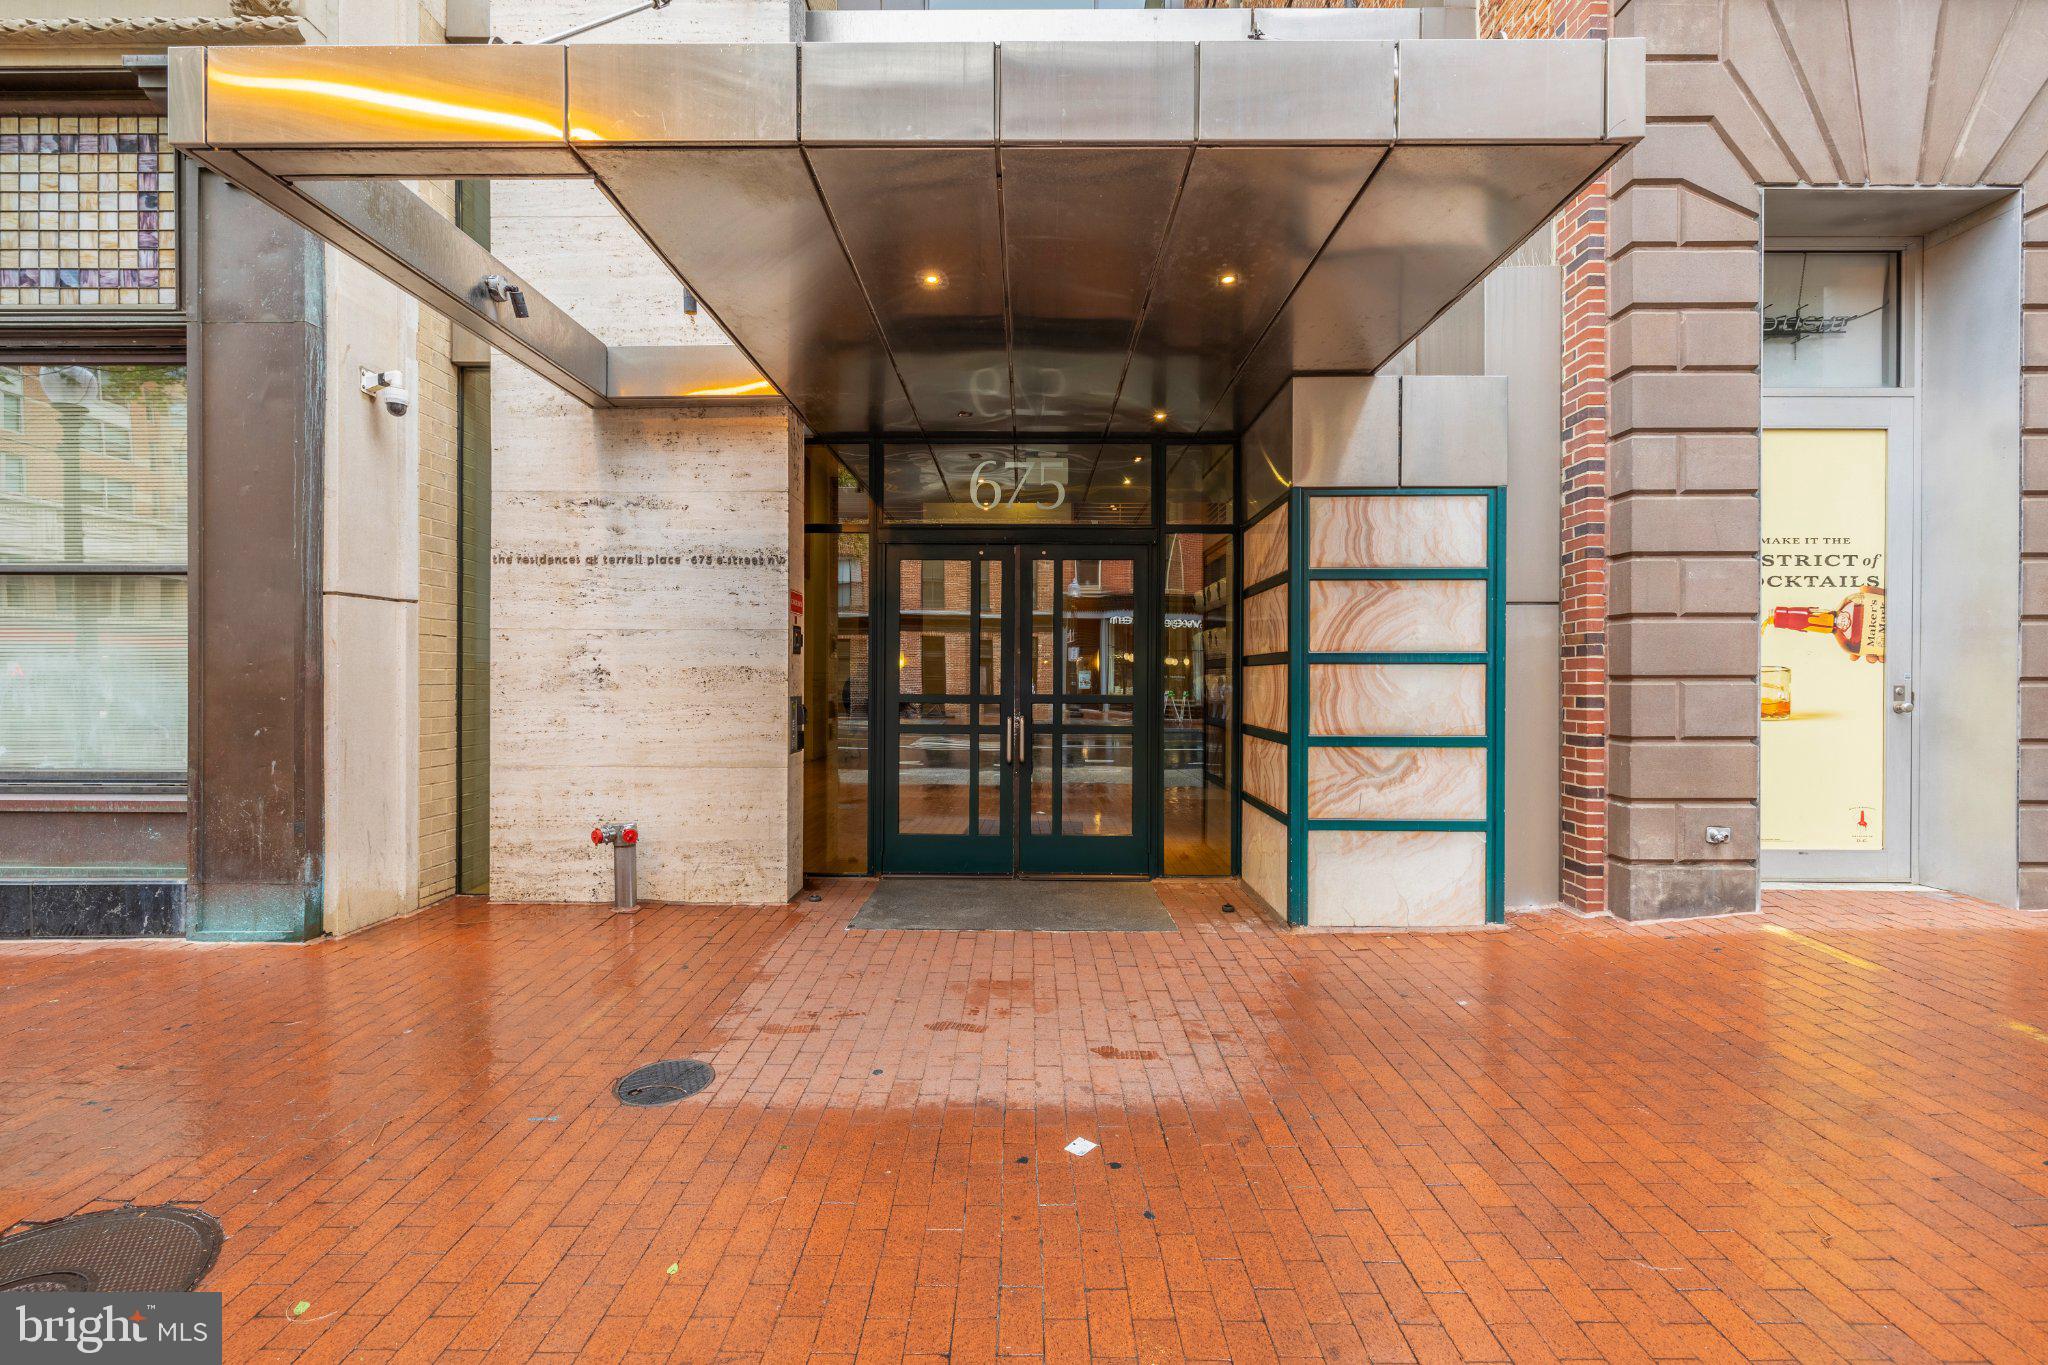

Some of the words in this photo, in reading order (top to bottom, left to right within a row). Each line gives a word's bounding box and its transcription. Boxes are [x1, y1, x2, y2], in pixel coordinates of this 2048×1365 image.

[969, 460, 1066, 510] 675
[1761, 537, 1800, 545] MAKE
[1804, 537, 1819, 545] IT
[1823, 537, 1851, 545] THE
[492, 553, 513, 565] the
[516, 553, 581, 565] residences
[585, 554, 599, 565] at
[602, 553, 643, 565] terrell
[647, 553, 681, 566] place
[690, 553, 713, 566] 675
[1761, 554, 1859, 567] STRICT
[1862, 553, 1882, 569] of
[1761, 575, 1880, 588] CKTAILS
[1866, 599, 1878, 647] Maker's
